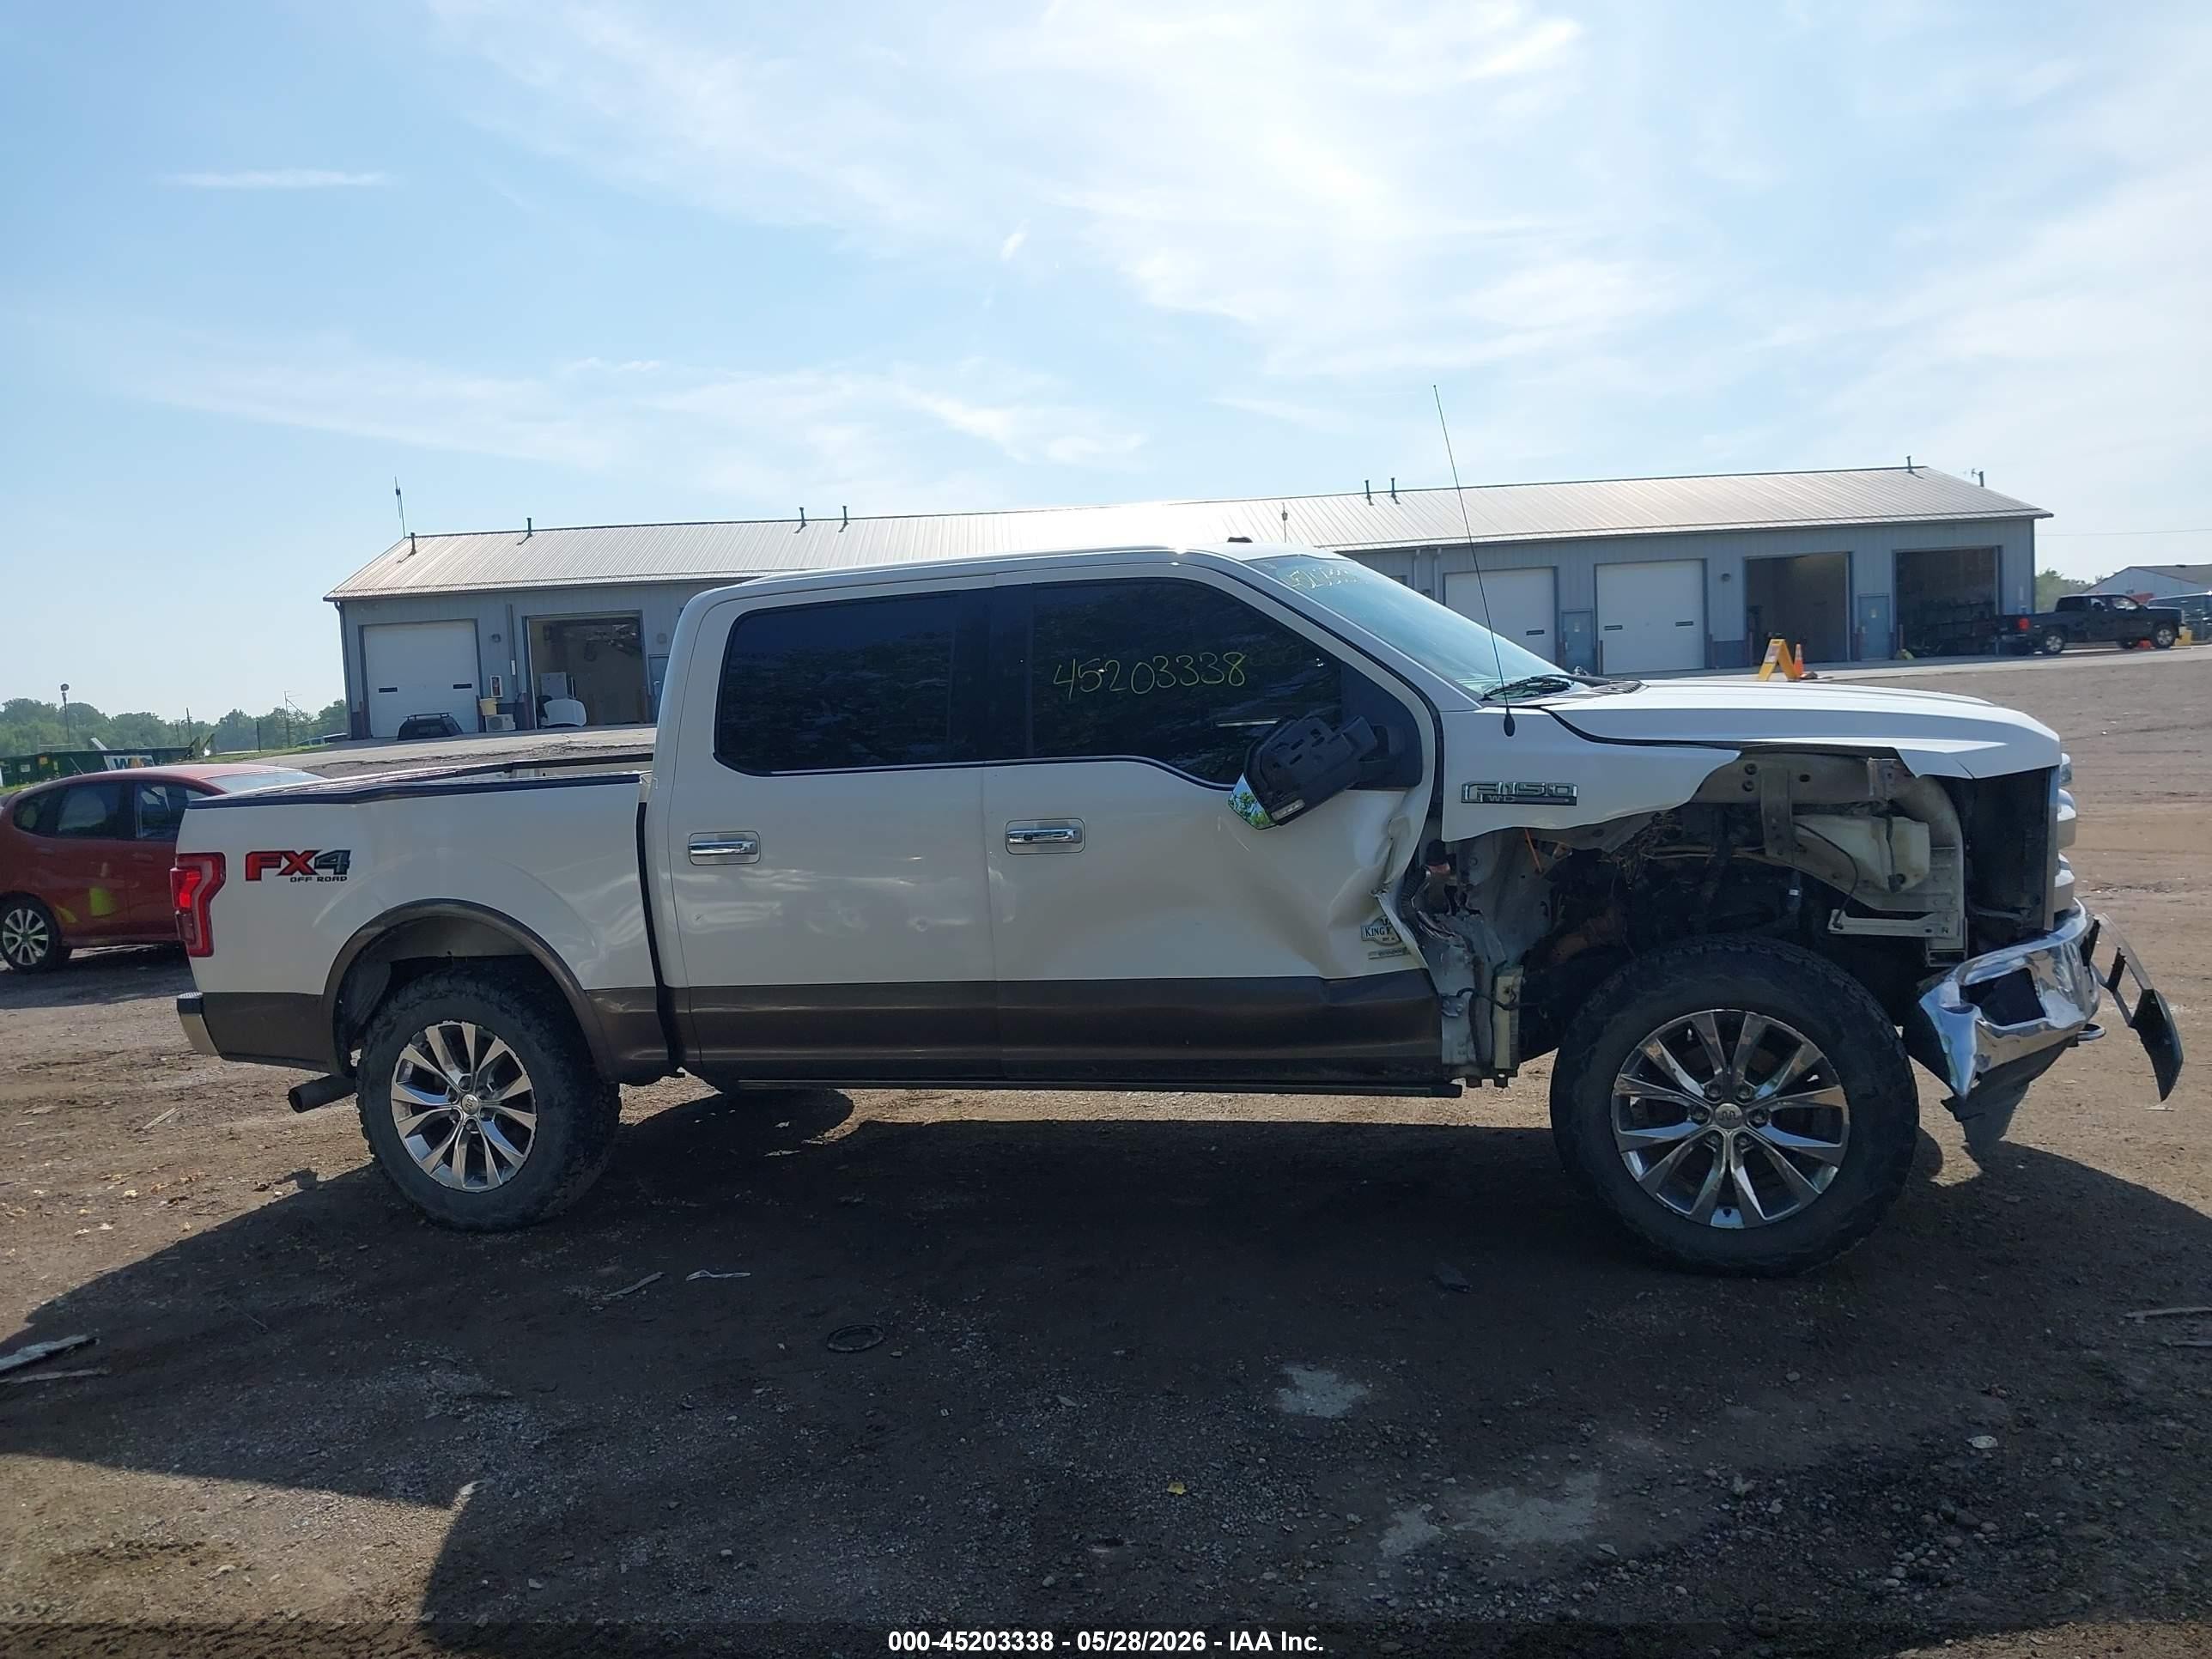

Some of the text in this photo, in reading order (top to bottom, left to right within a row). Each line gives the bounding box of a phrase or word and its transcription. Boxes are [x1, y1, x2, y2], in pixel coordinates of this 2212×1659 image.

[1053, 652, 1246, 701] 45203338
[245, 849, 351, 881] FX4
[1364, 927, 1385, 937] KING
